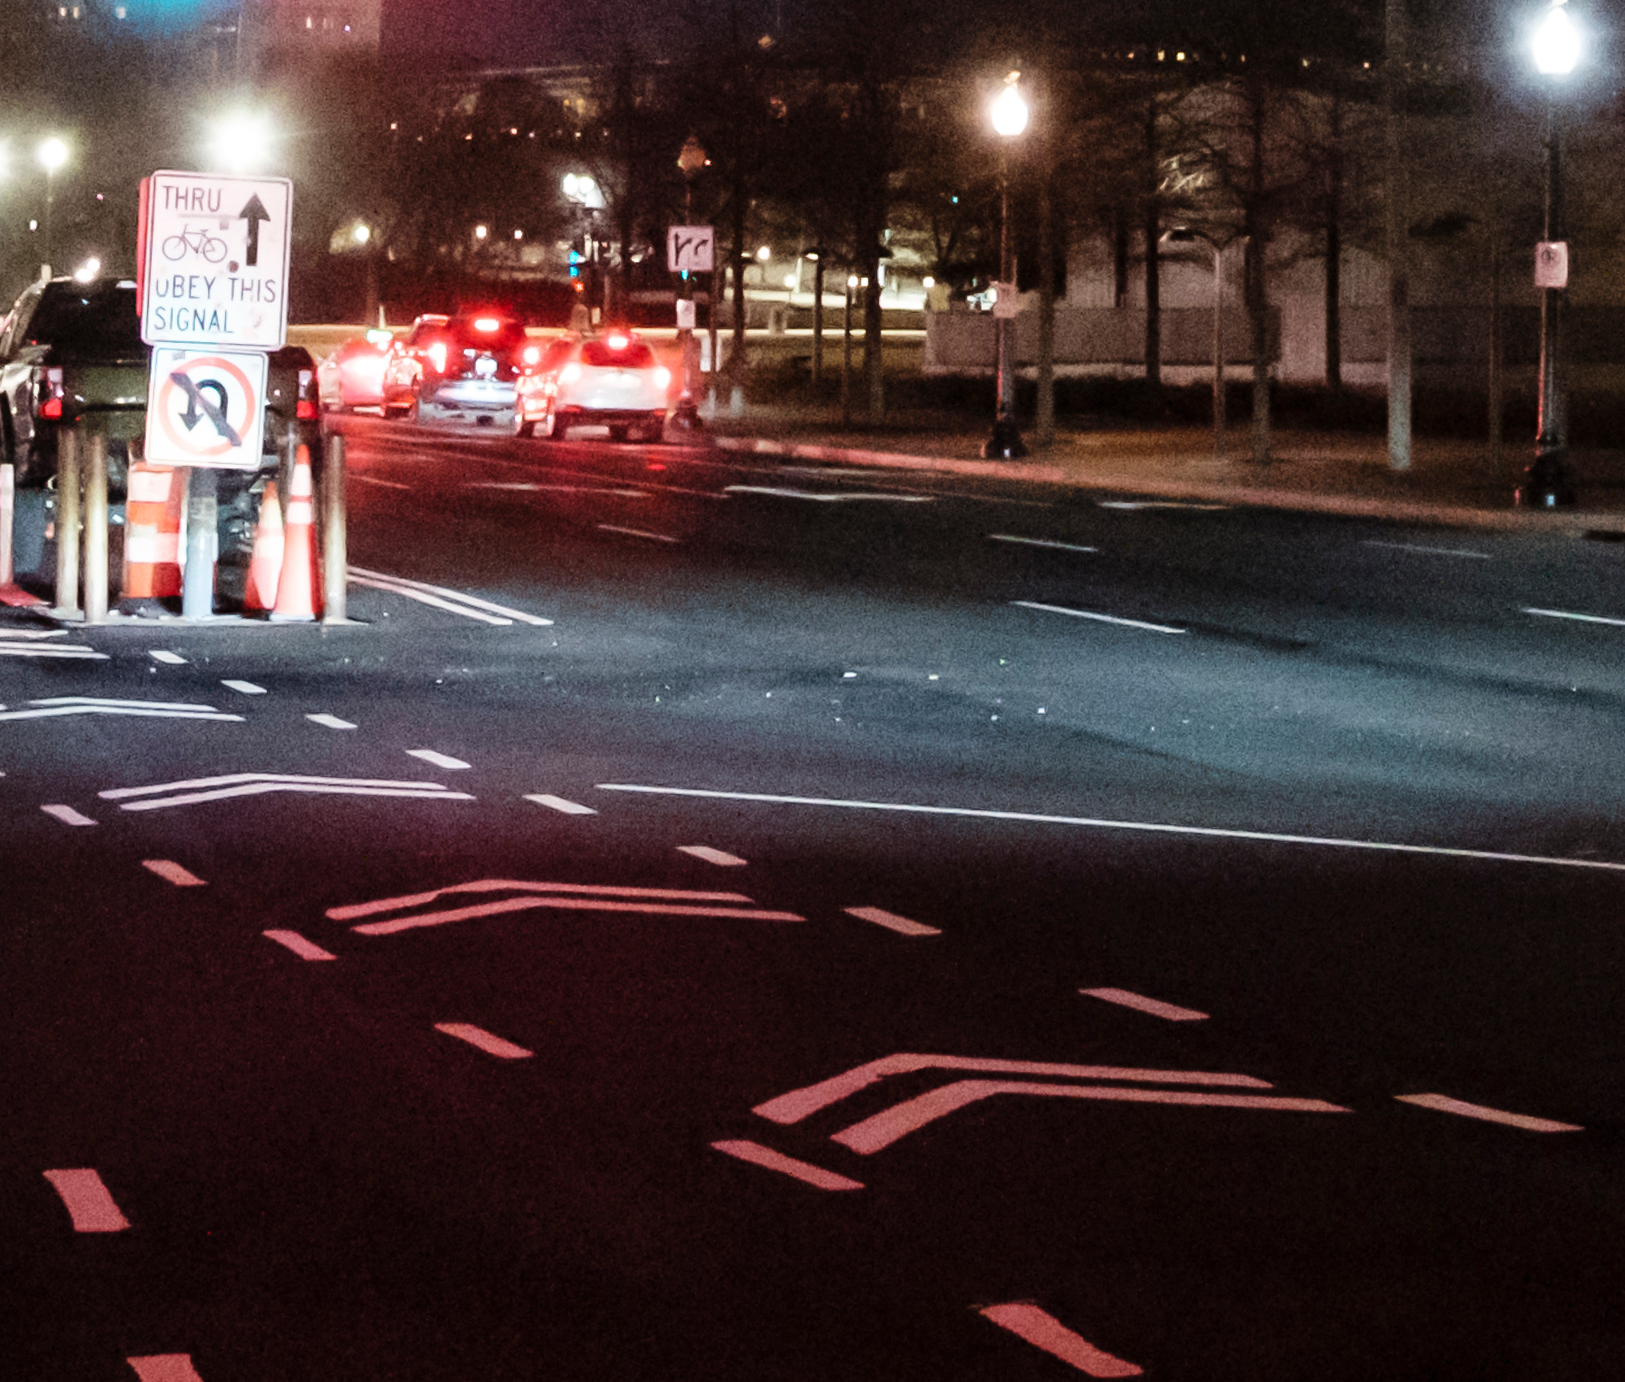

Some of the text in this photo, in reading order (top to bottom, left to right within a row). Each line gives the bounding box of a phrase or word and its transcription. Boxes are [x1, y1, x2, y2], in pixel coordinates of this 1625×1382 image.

[162, 185, 221, 212] THRU
[227, 277, 276, 303] THIS
[154, 306, 234, 333] SIGNAL
